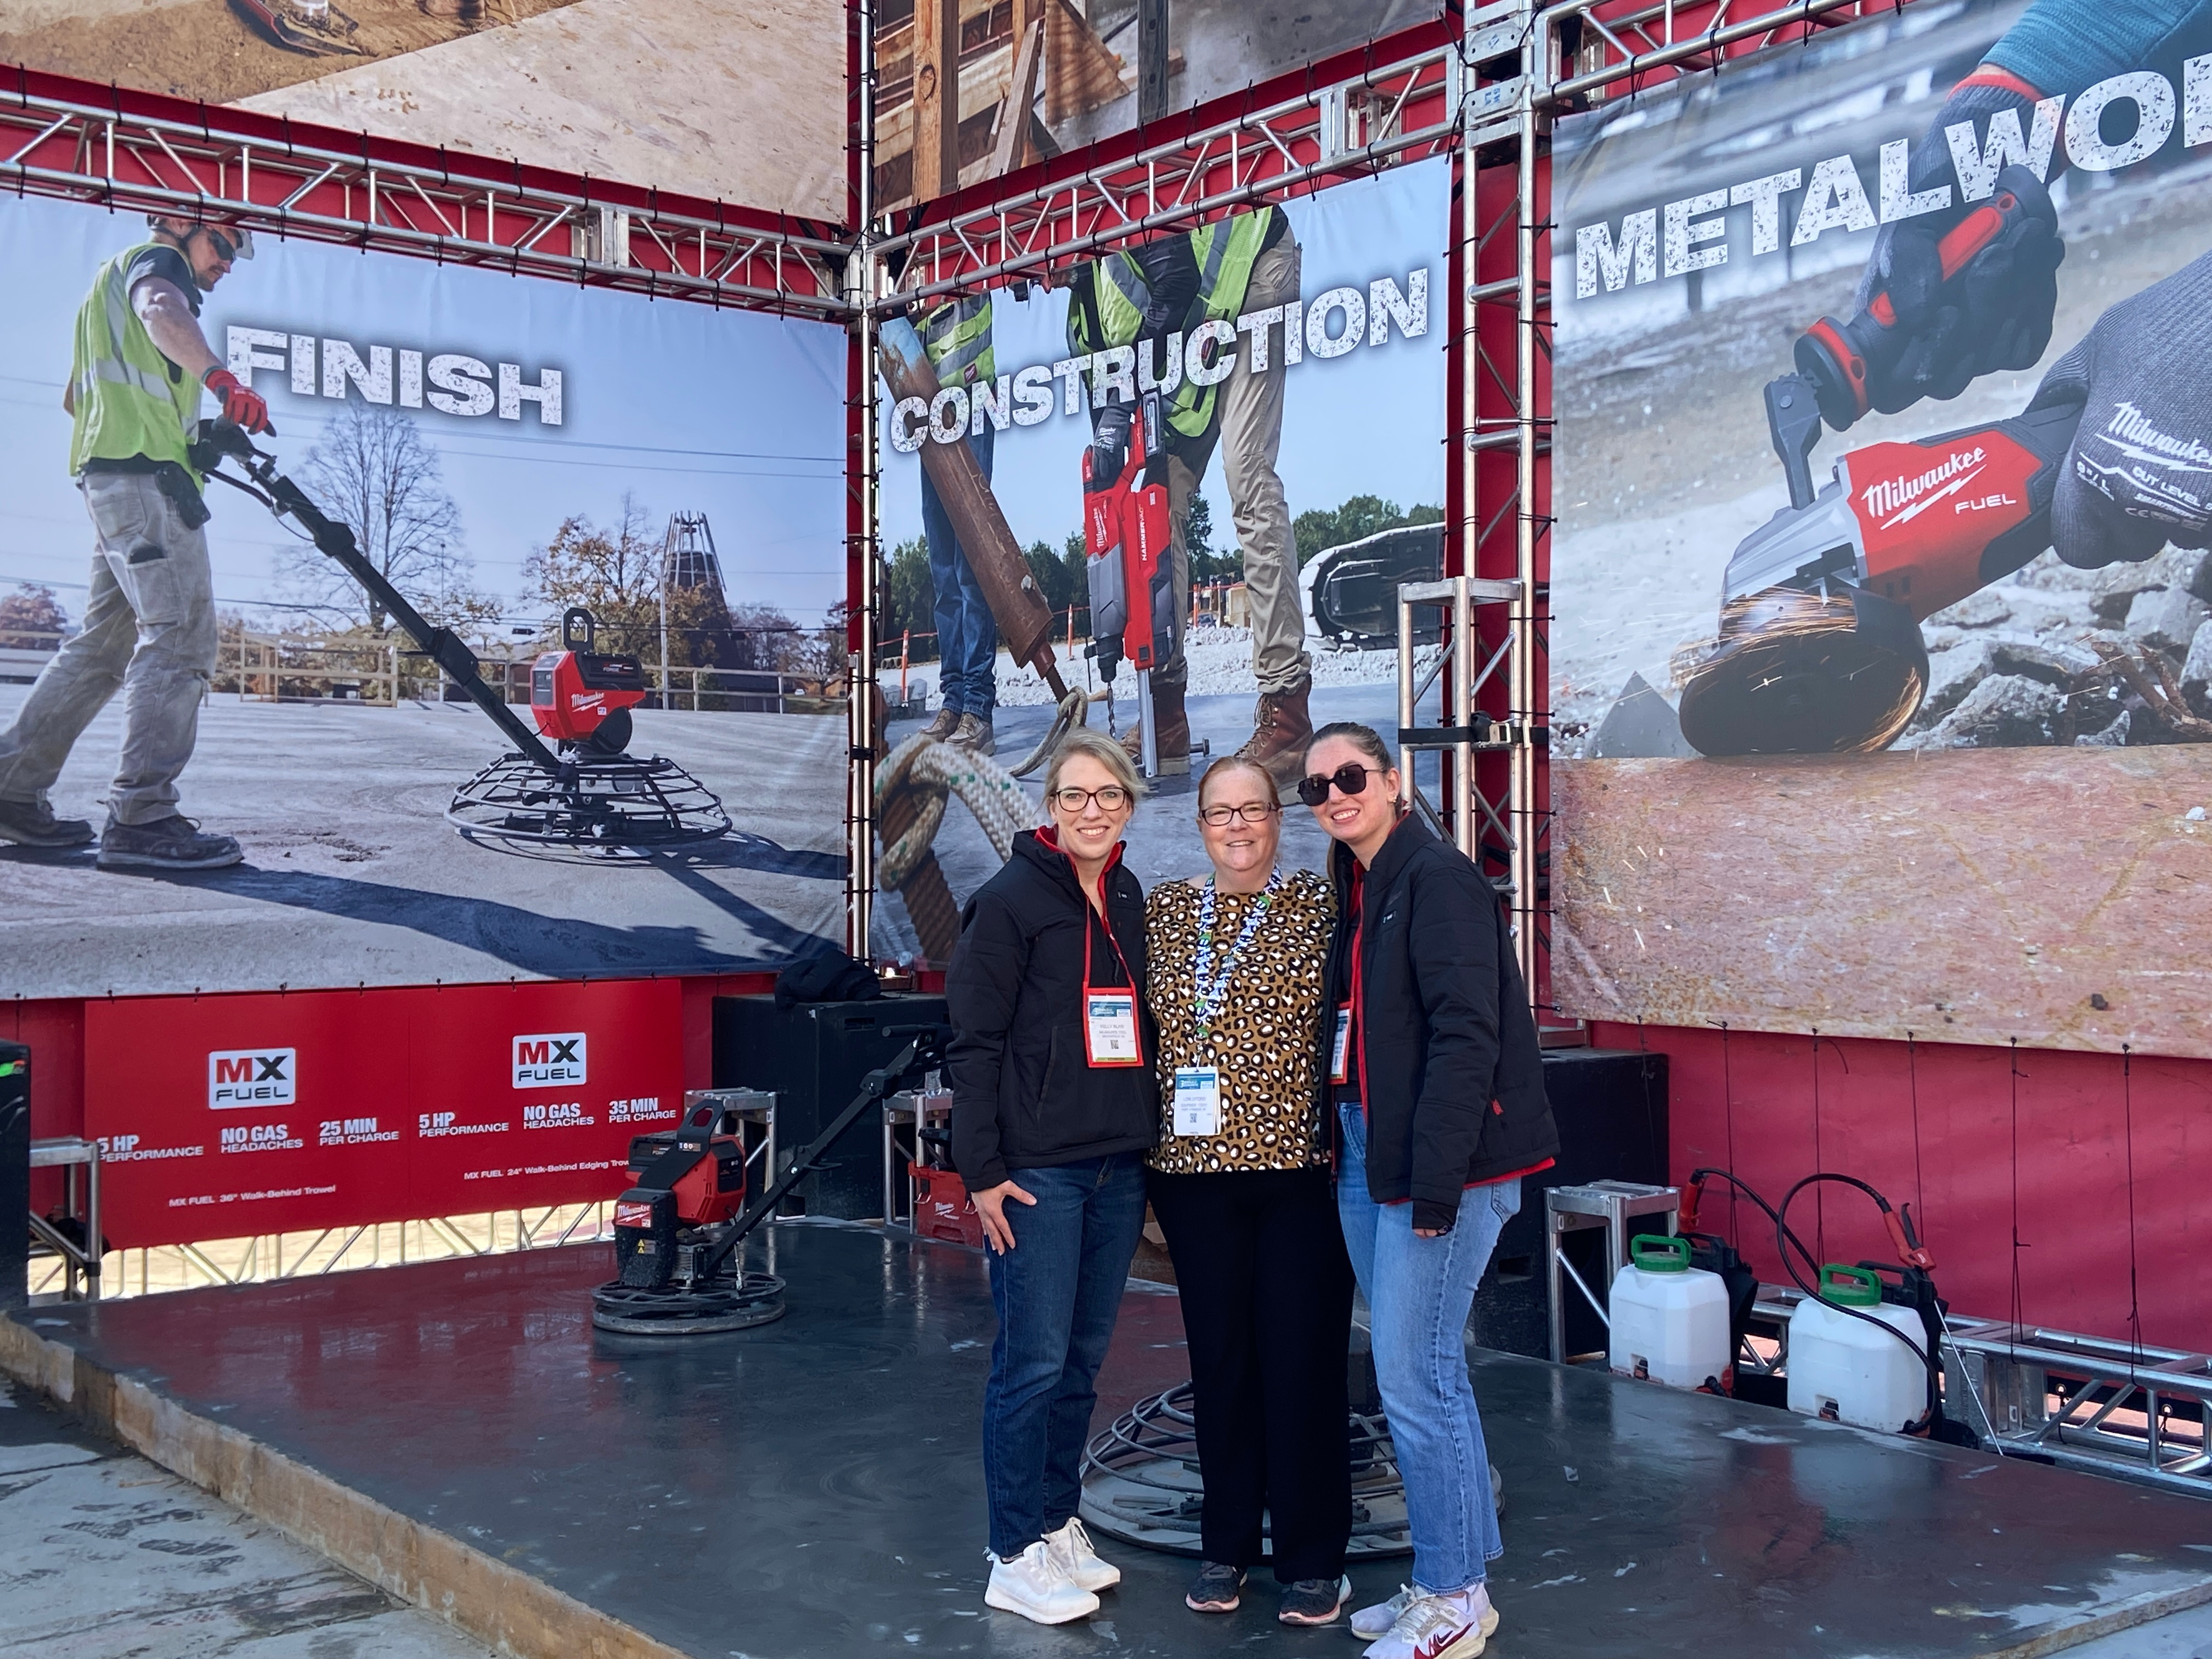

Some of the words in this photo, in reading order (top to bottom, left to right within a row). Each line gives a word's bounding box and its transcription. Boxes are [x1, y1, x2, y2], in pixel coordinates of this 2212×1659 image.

[890, 268, 1427, 453] CONSTRUCTION
[227, 325, 562, 425] FINISH
[1861, 447, 1987, 518] Milwaukee
[2132, 466, 2161, 486] CUT
[2160, 482, 2201, 507] LEVEL
[1955, 494, 2017, 514] FUEL
[518, 1039, 579, 1065] MX
[216, 1055, 289, 1084] MX
[518, 1068, 580, 1082] FUEL
[216, 1086, 289, 1102] FUEL
[523, 1106, 546, 1121] NO
[548, 1103, 580, 1118] GAS
[609, 1100, 628, 1115] 35
[630, 1097, 658, 1113] MIN
[419, 1114, 430, 1129] 5
[432, 1112, 455, 1127] HP
[523, 1116, 594, 1130] HEADACHES
[609, 1114, 630, 1124] PER
[633, 1109, 676, 1121] CHARGE
[221, 1126, 248, 1144] NO
[251, 1124, 288, 1142] GAS
[319, 1121, 341, 1137] 25
[344, 1118, 377, 1135] MIN
[419, 1122, 509, 1138] PERFORMANCE
[97, 1137, 110, 1153] 5
[113, 1134, 140, 1152] HP
[221, 1139, 303, 1153] HEADACHES
[319, 1135, 344, 1147] PER
[347, 1131, 399, 1144] CHARGE
[481, 1170, 504, 1178] FUEL
[525, 1163, 577, 1175] Walk-Behind
[579, 1161, 609, 1170] Edging
[169, 1199, 186, 1207] MX
[189, 1195, 215, 1205] FUEL
[241, 1188, 302, 1200] Walk-Behind
[304, 1184, 336, 1194] Trowel
